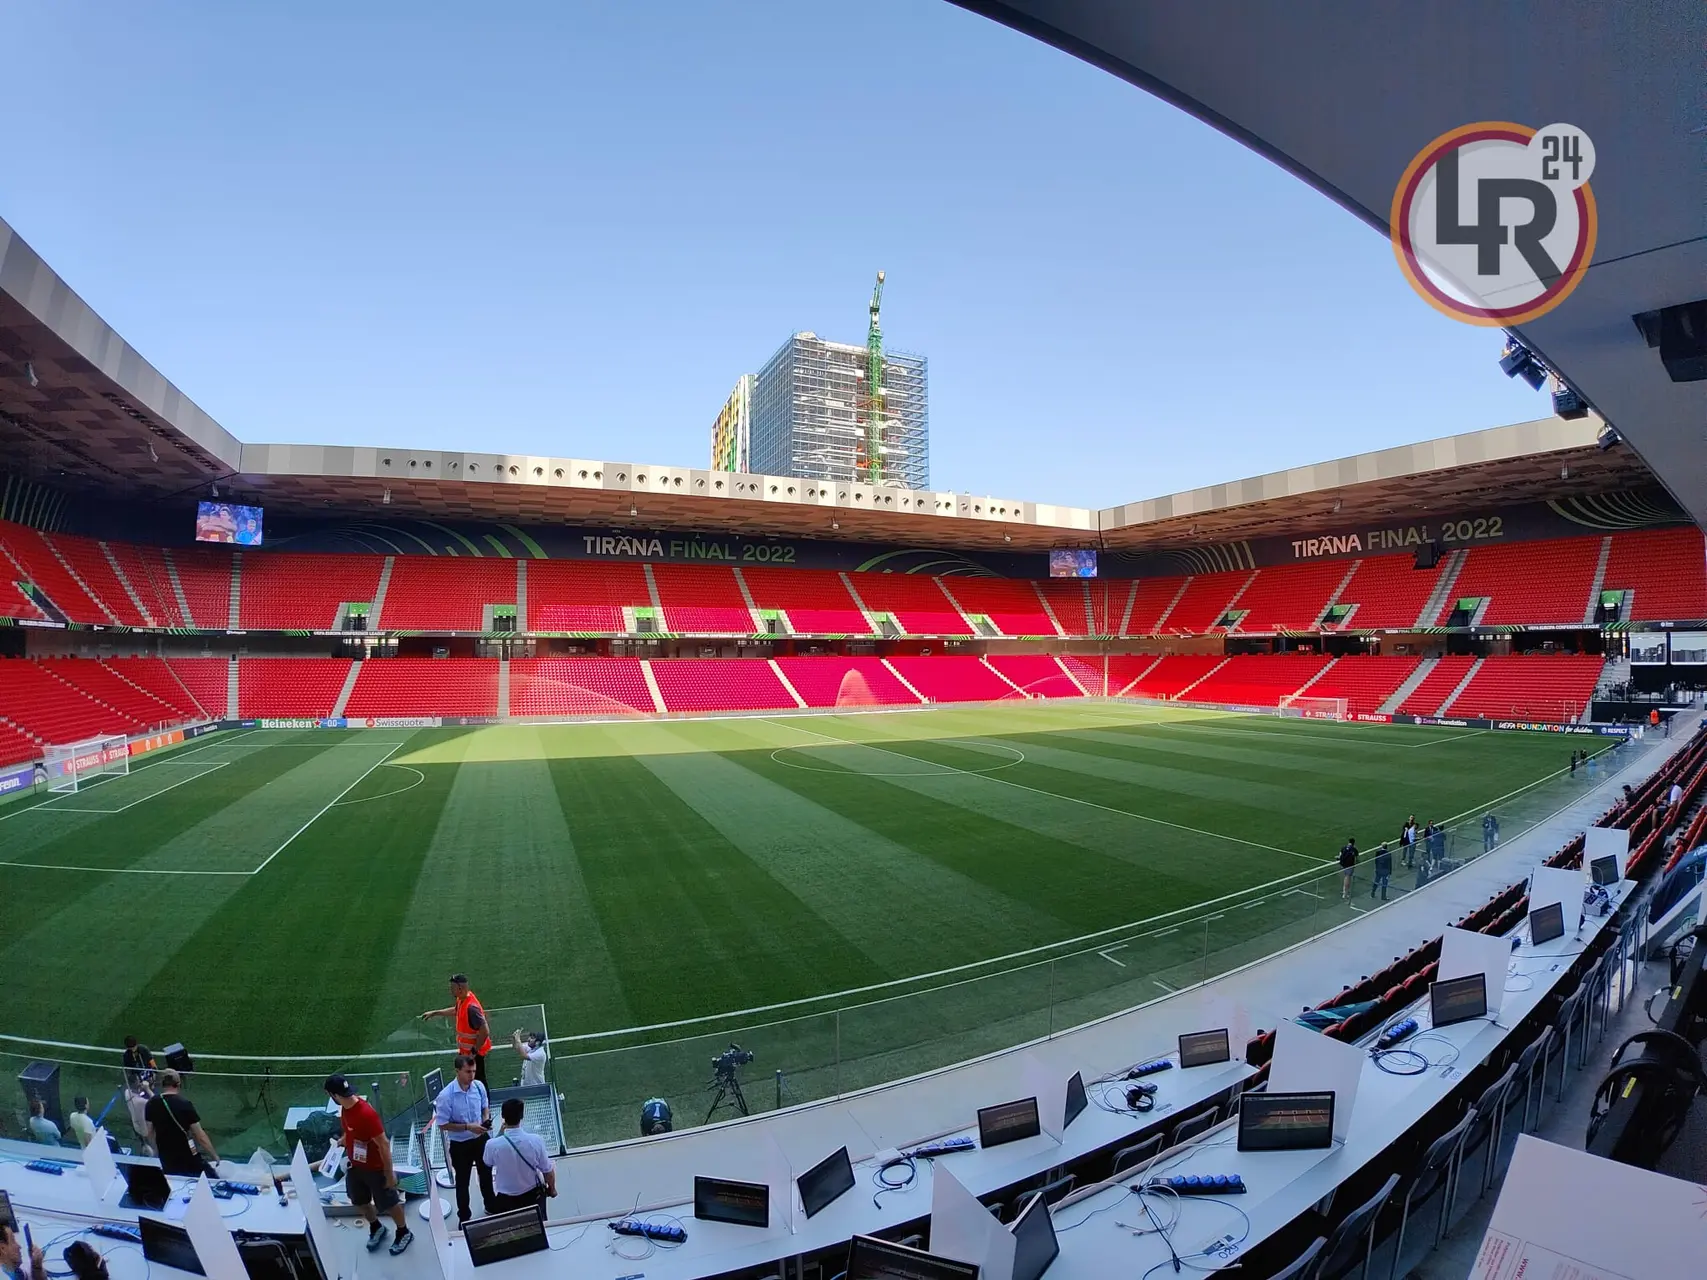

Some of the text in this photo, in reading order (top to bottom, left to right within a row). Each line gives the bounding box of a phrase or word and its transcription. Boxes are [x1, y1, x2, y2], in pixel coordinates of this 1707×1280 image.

[1367, 526, 1436, 550] FINAL
[1441, 516, 1504, 543] 2022
[670, 540, 737, 560] FINAL
[742, 544, 796, 563] 2022
[261, 718, 312, 729] Heineken
[376, 718, 424, 728] Swissquote
[1357, 714, 1387, 722] STRAUSS
[1516, 723, 1564, 732] FOUNDATION
[1564, 725, 1573, 734] for
[76, 754, 100, 769] STRAUSS
